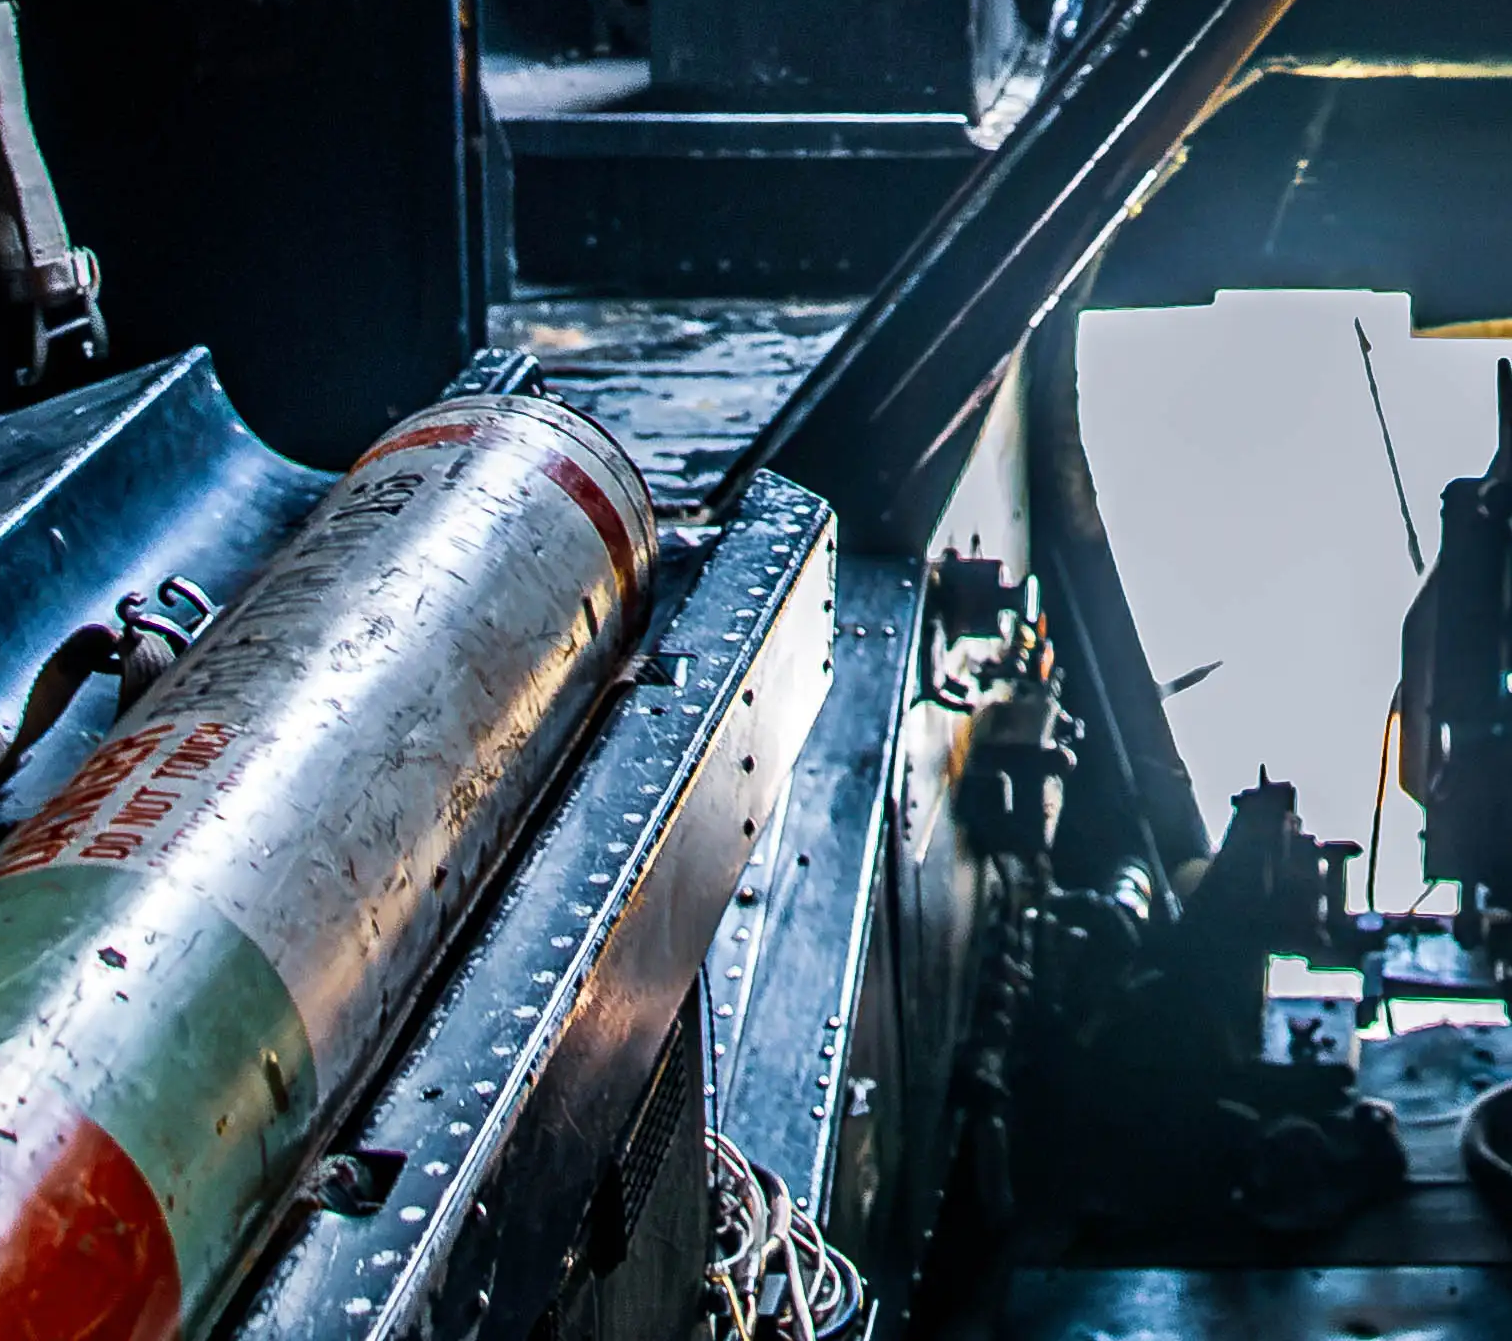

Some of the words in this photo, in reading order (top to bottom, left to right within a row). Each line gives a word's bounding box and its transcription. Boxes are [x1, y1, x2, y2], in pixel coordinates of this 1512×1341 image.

[150, 721, 238, 781] TOUCH
[108, 784, 182, 829] NOT
[79, 832, 144, 860] DO
